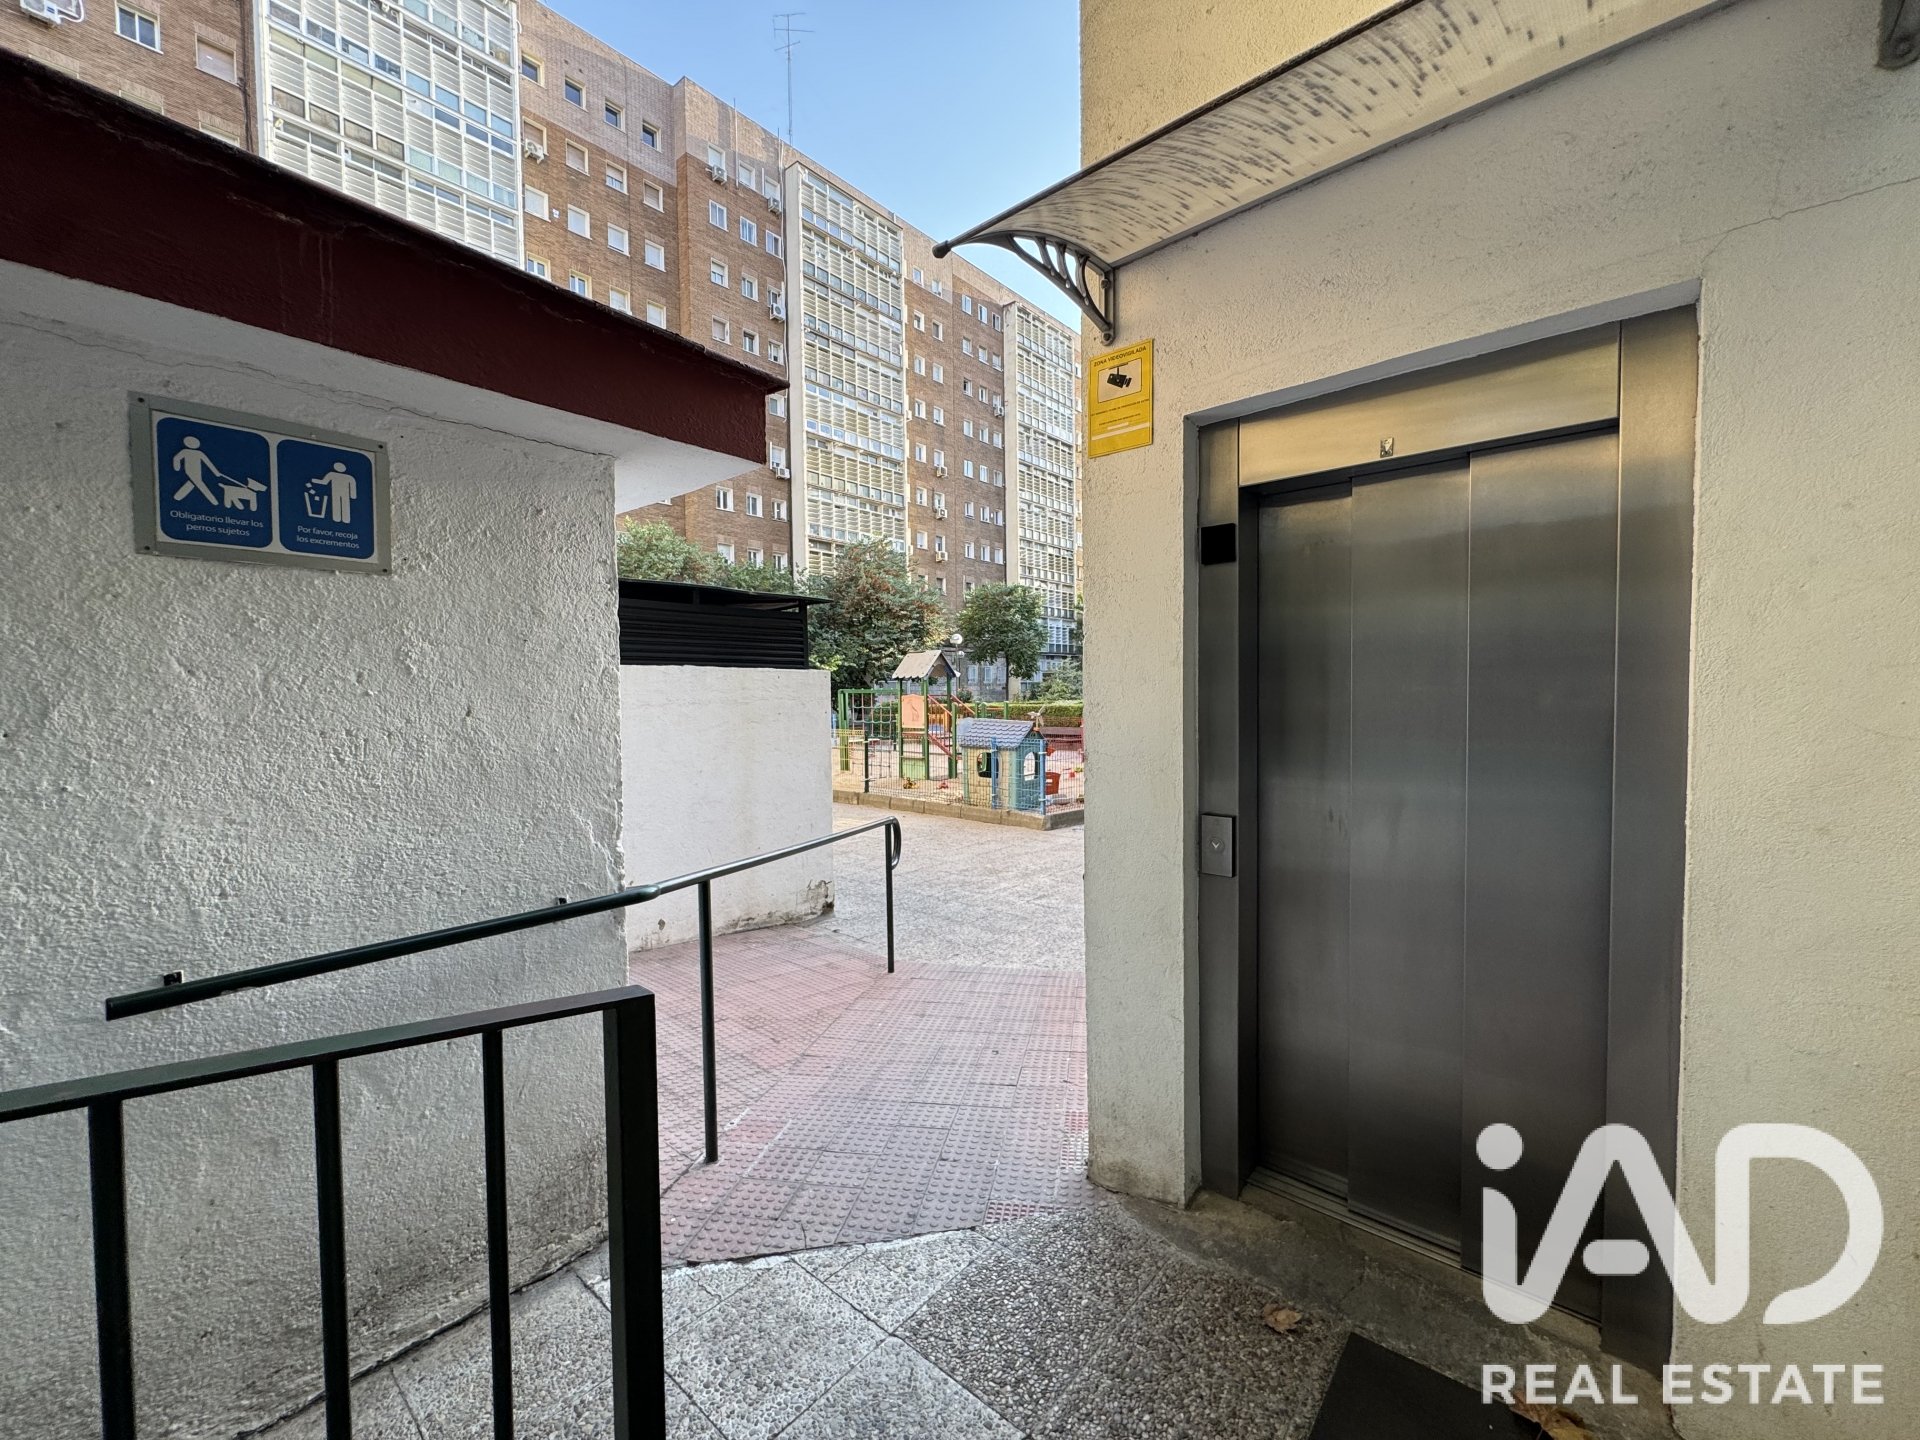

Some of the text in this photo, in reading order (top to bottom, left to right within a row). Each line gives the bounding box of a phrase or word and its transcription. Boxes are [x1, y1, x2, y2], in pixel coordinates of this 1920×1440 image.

[1094, 345, 1147, 367] ZONA VIDEOVIGILADA
[170, 510, 264, 528] Obligatorio llevar los
[186, 524, 250, 536] perros sujetos
[297, 525, 358, 540] Por favor, recoja
[296, 535, 360, 549] los excrementos
